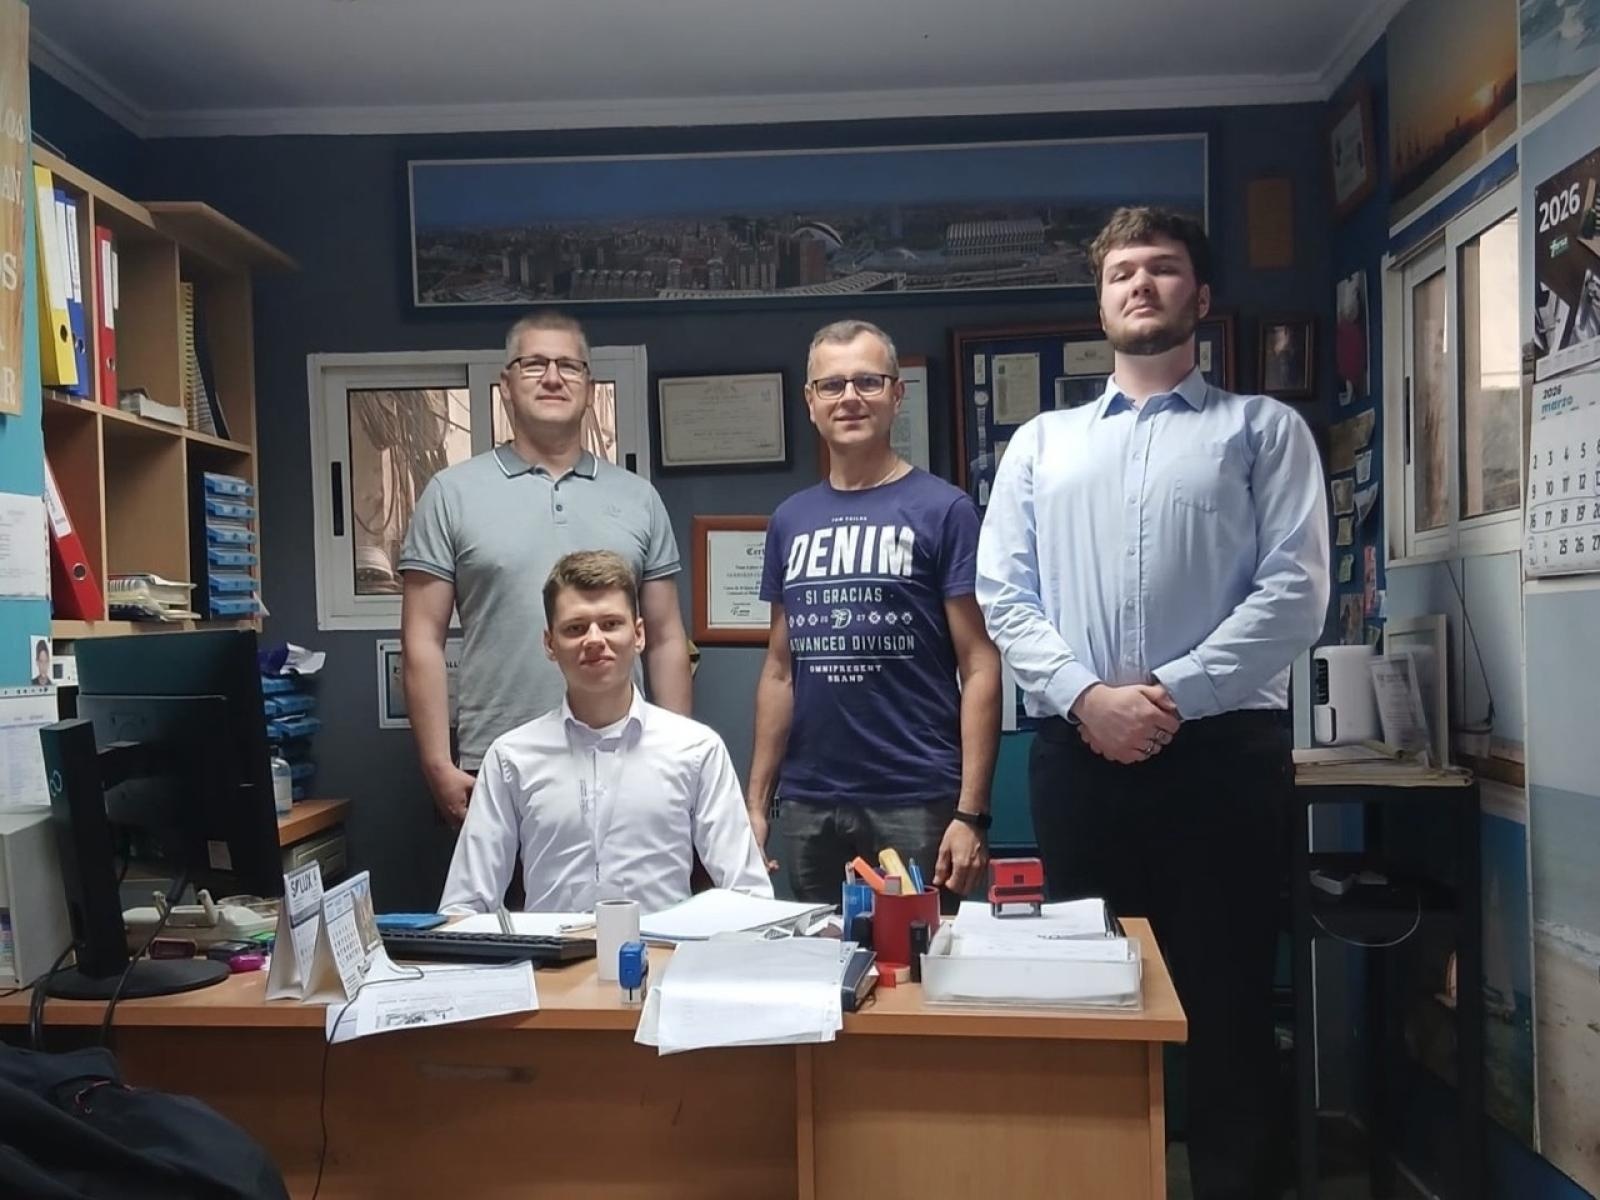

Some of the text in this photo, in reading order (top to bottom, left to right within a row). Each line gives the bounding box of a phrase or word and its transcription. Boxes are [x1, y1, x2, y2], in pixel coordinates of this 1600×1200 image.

[1540, 182, 1580, 233] 2026
[1542, 395, 1573, 414] marzo
[1581, 442, 1586, 458] 5
[1546, 480, 1554, 496] 10
[1562, 475, 1570, 493] 11
[1579, 473, 1586, 490] 12
[1545, 510, 1552, 527] 17
[1561, 507, 1568, 524] 18
[1576, 504, 1586, 521] 19
[785, 525, 915, 582] DENIM
[1559, 537, 1568, 555] 25
[1575, 536, 1584, 553] 26
[805, 587, 883, 605] SI GRACIAS
[790, 635, 915, 652] ADVANCED DIVISION
[828, 674, 864, 683] BRAND
